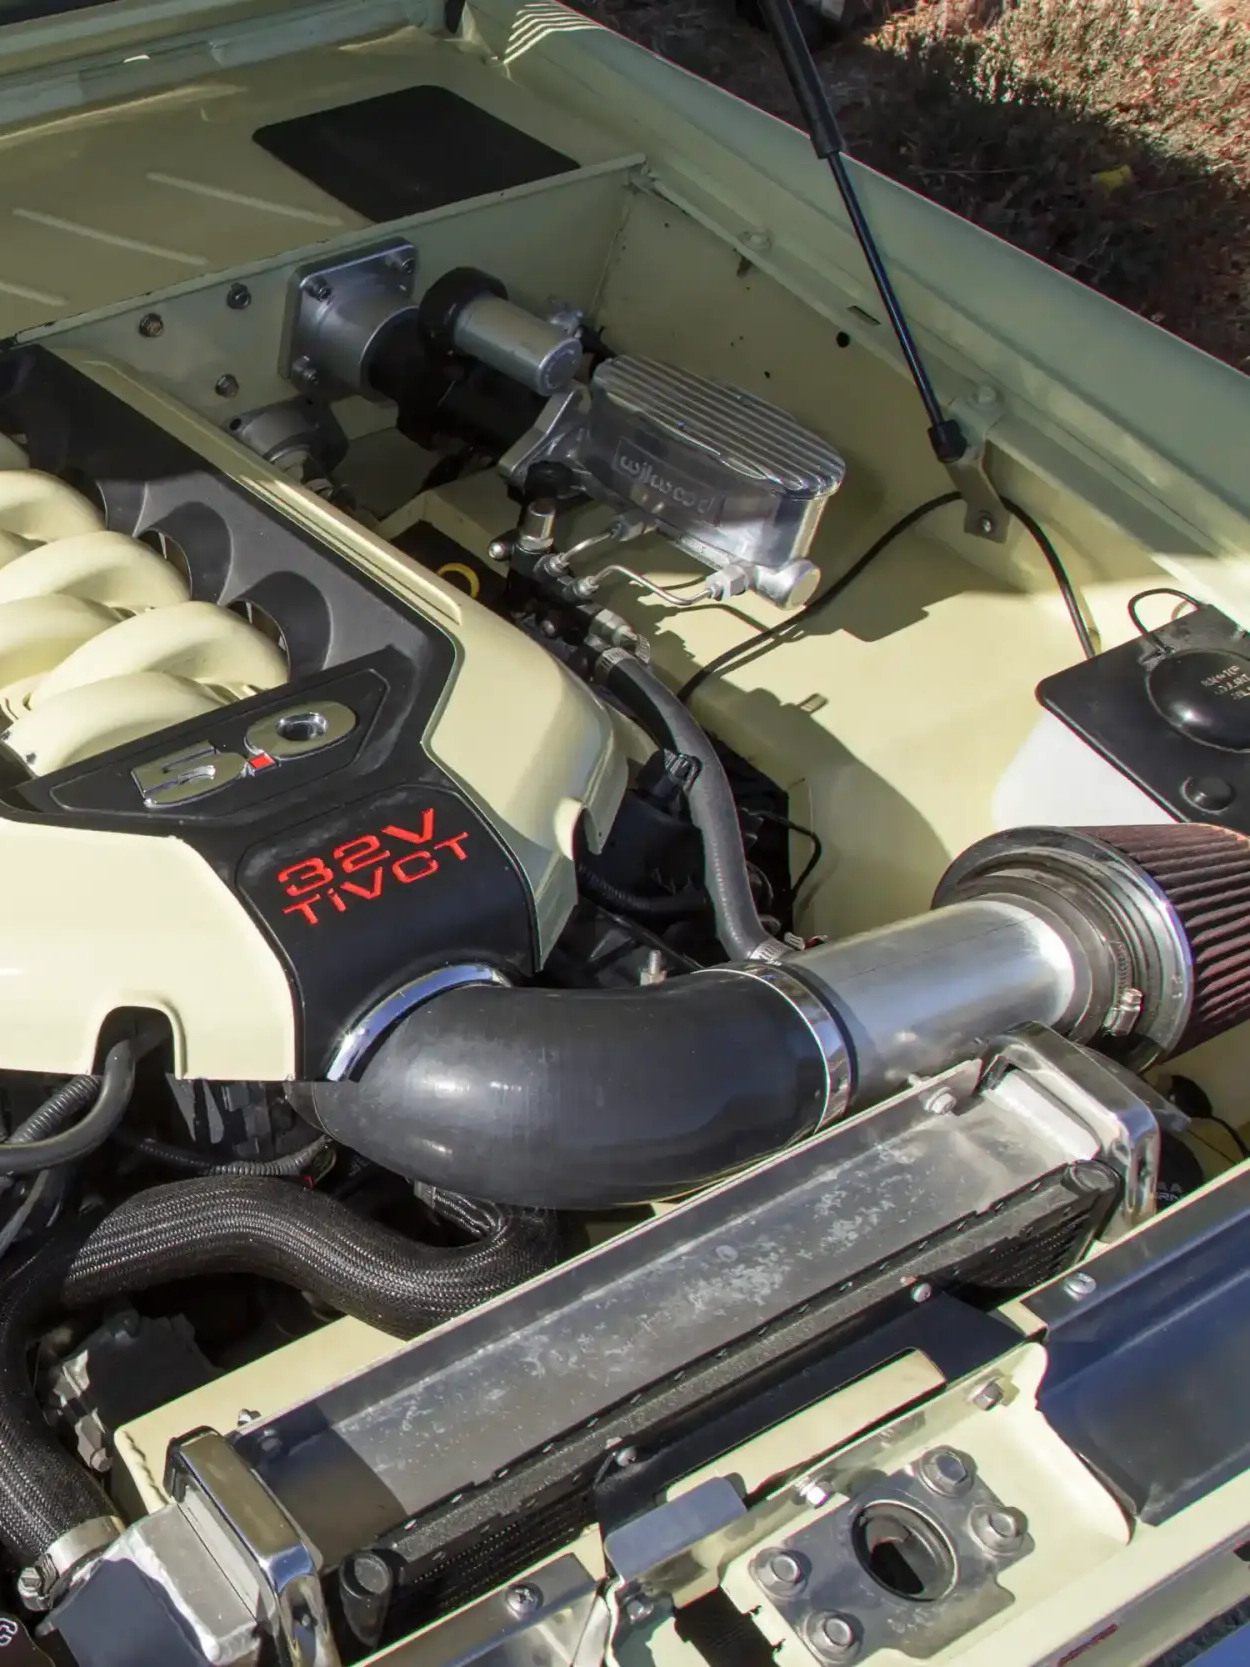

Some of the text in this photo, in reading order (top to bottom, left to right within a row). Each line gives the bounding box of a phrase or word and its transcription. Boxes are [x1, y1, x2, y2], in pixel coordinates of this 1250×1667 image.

[618, 453, 716, 514] wilwood
[131, 700, 358, 808] 5.0
[277, 807, 436, 897] 32V
